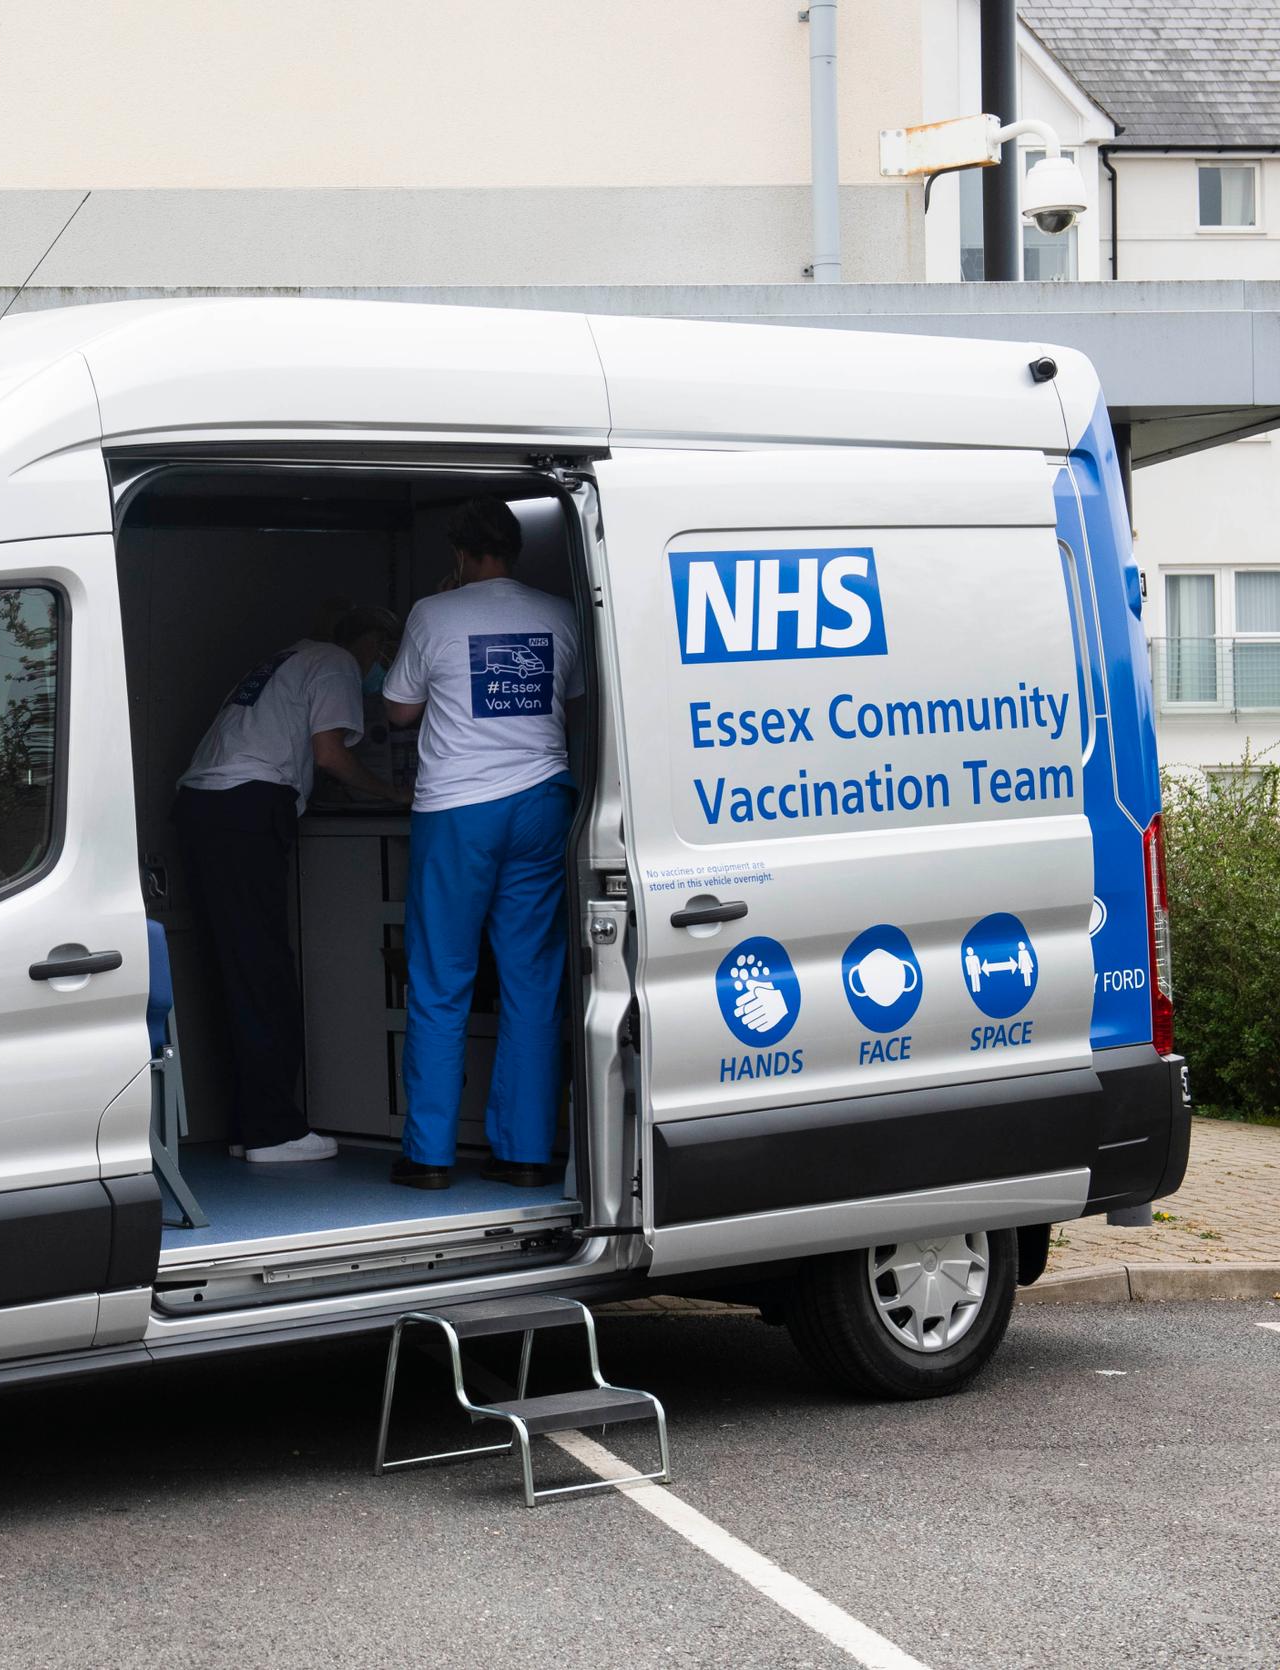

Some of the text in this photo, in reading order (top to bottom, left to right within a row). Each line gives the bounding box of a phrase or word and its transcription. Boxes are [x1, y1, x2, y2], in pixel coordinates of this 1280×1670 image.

[684, 554, 873, 655] NHS
[528, 637, 549, 647] NHS
[487, 681, 542, 695] #Essex
[485, 696, 542, 710] Vax Van
[689, 681, 1070, 749] Essex Community
[693, 759, 1075, 826] Vaccination Team
[646, 861, 765, 879] No vaccines or equipment are
[649, 872, 775, 892] stored in this vehicle overnight.
[1103, 968, 1146, 993] FORD
[969, 1020, 1035, 1052] SPACE
[858, 1035, 913, 1066] FACE
[719, 1048, 805, 1083] HANDS
